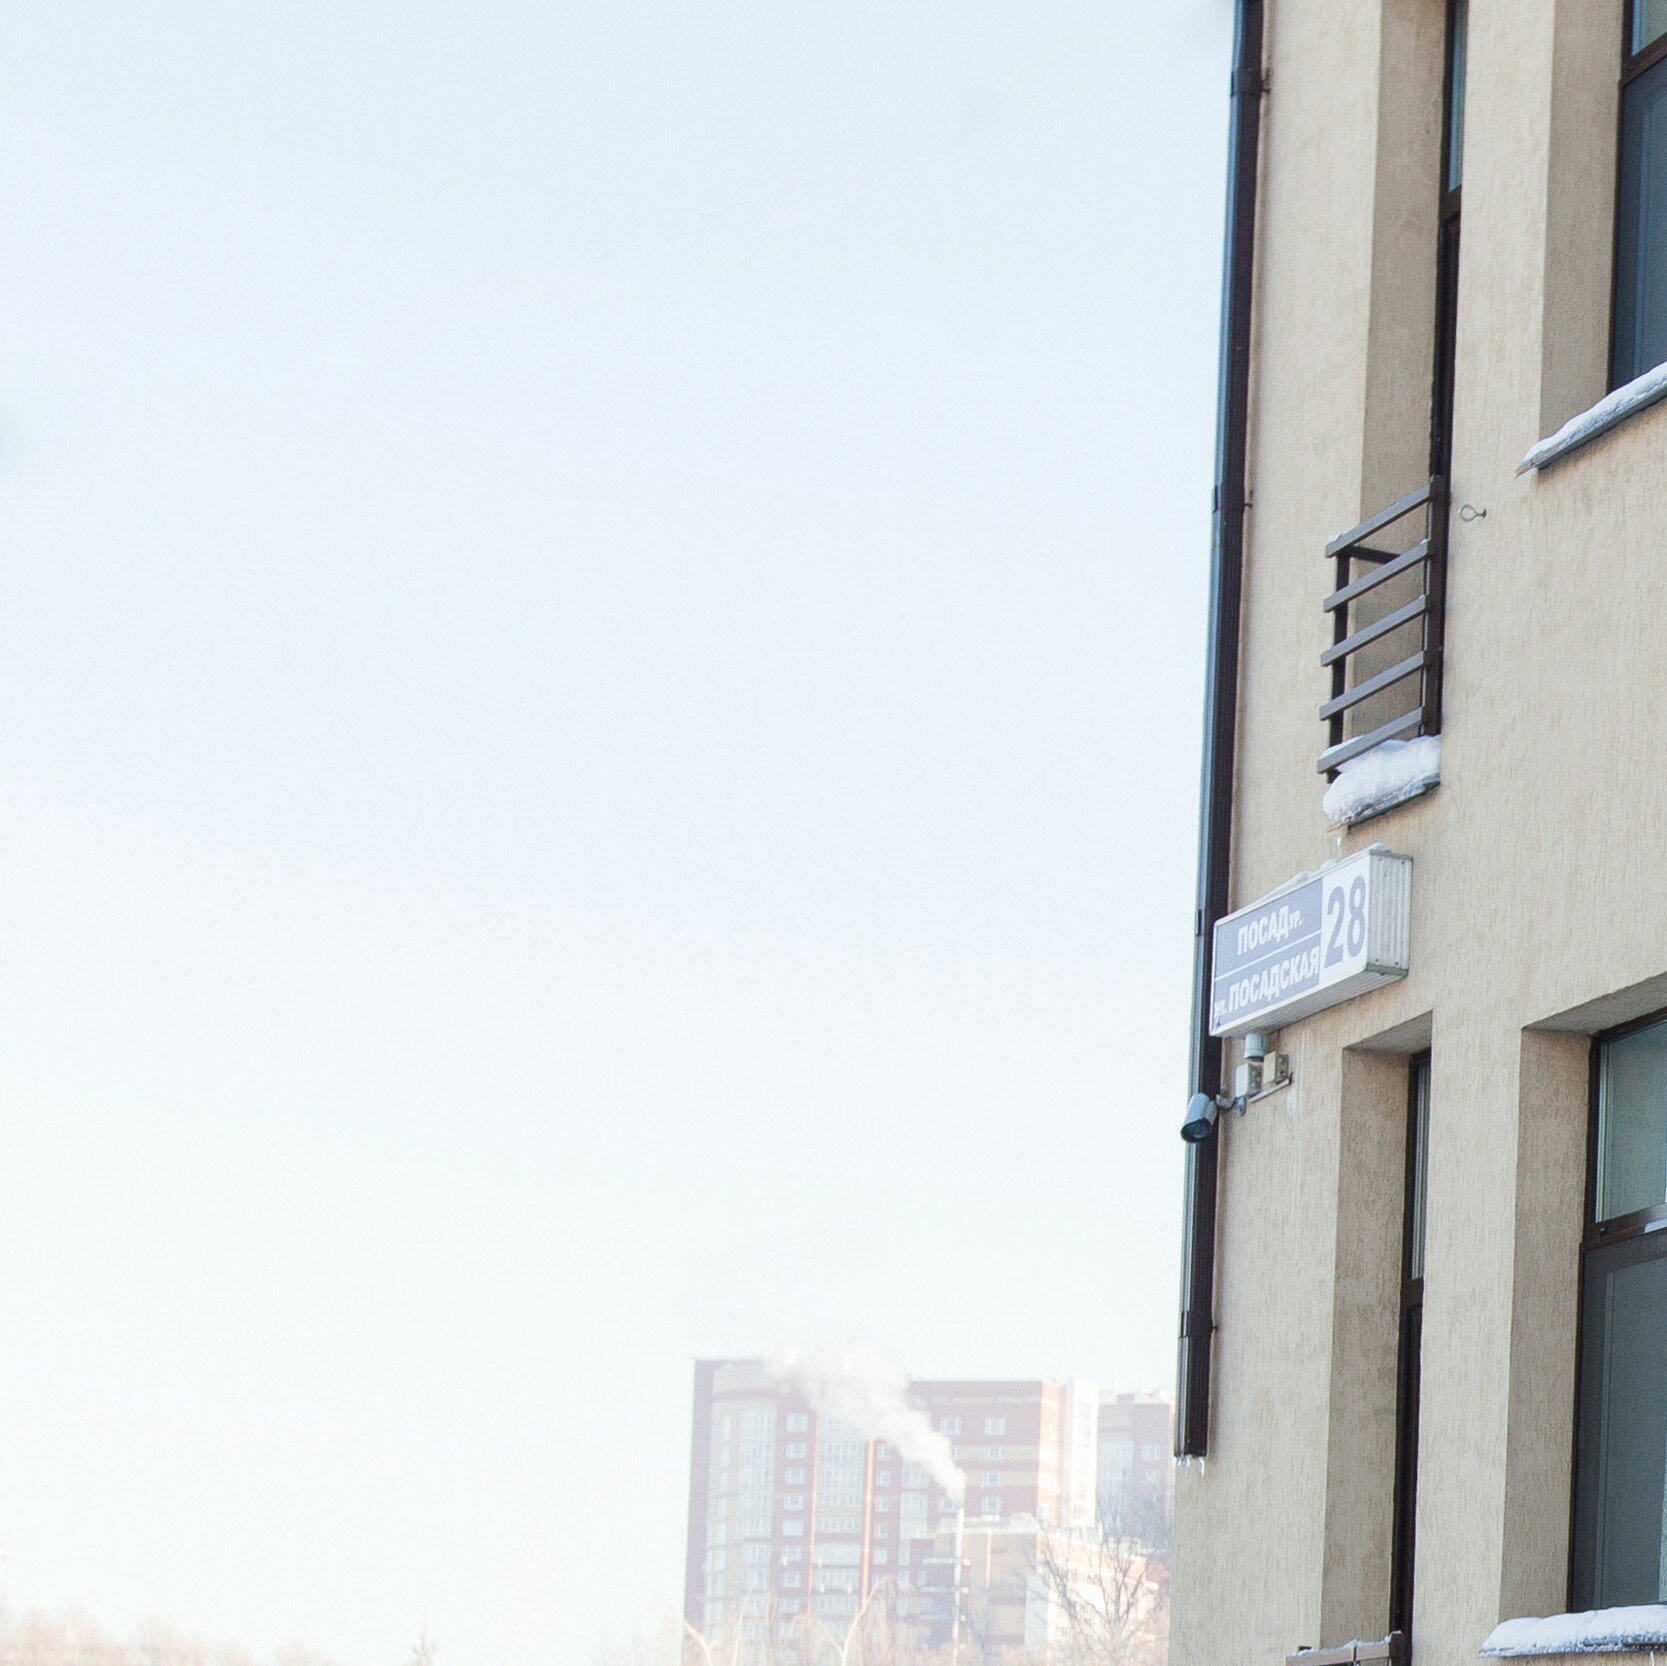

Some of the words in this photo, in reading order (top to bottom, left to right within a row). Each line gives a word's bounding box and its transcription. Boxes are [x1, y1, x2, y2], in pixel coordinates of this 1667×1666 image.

[1236, 905, 1289, 956] ПОСАД
[1324, 875, 1366, 969] 28
[1228, 945, 1320, 1014] ПОСАДСКАЯ
